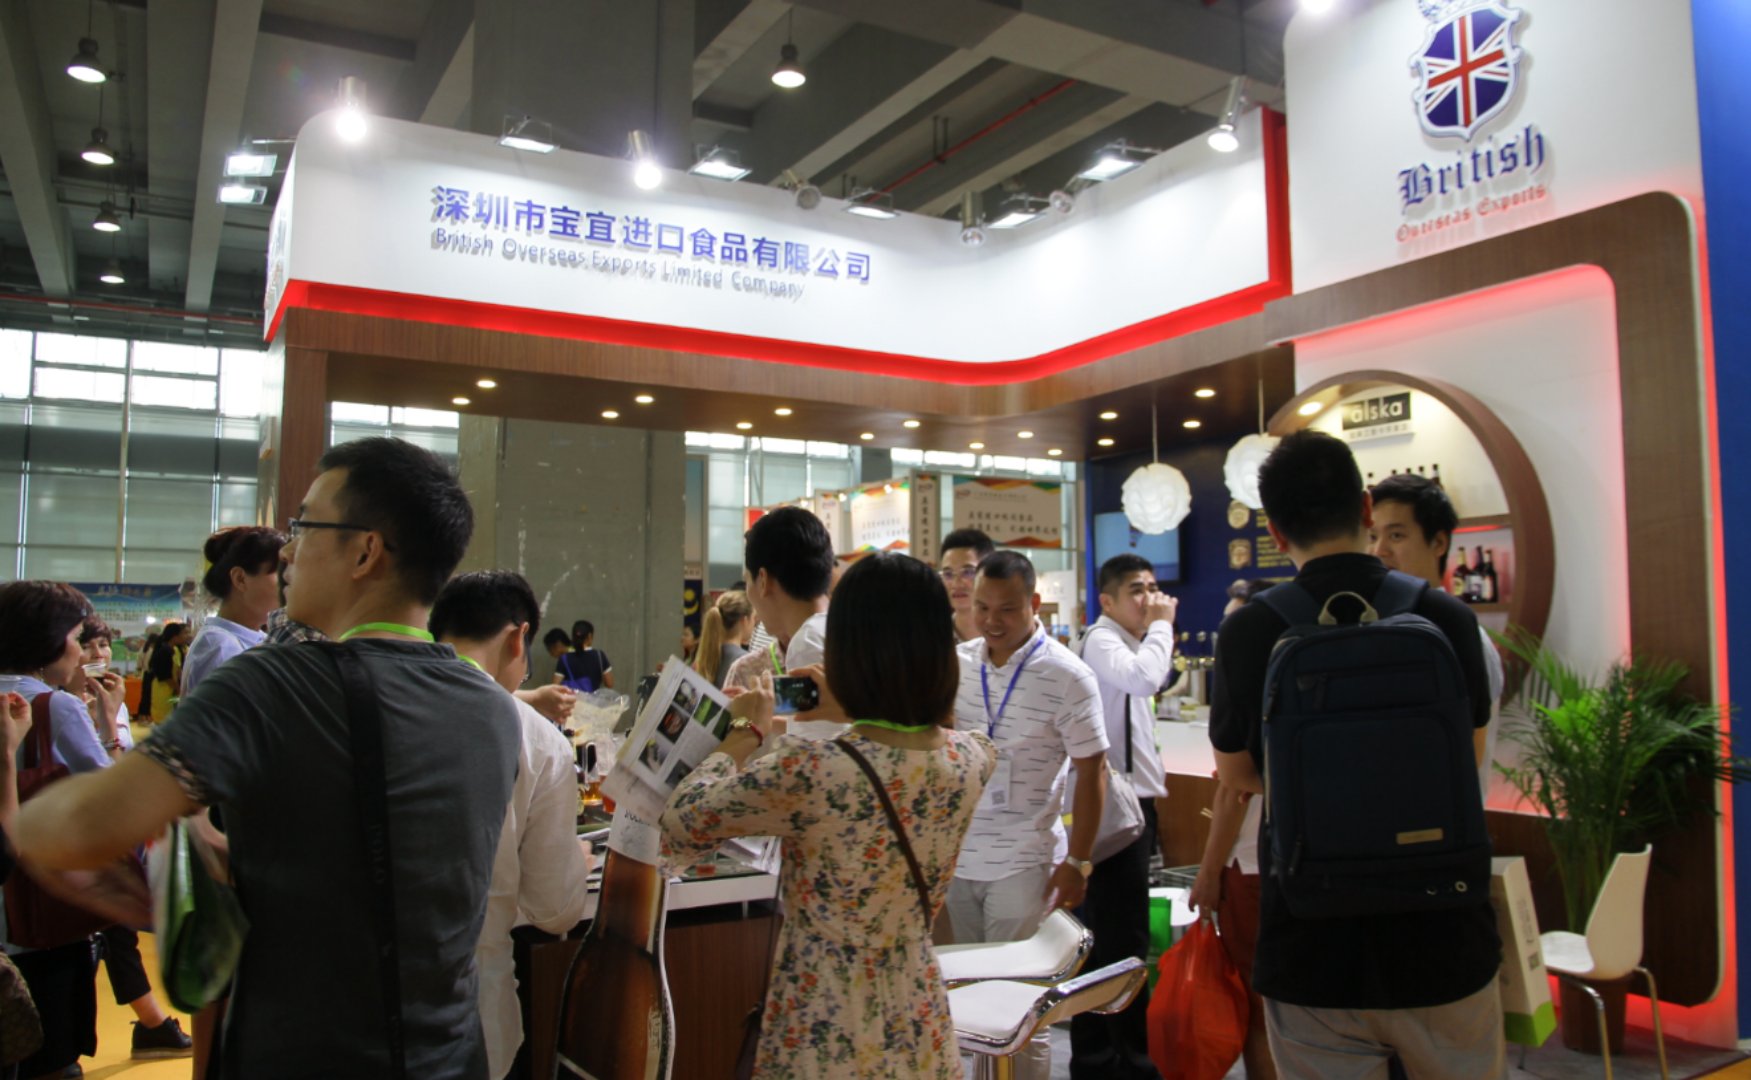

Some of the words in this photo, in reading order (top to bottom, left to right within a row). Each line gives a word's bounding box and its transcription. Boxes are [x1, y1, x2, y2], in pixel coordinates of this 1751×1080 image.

[1398, 122, 1545, 215] British
[1477, 184, 1547, 216] Exports
[434, 183, 873, 282] 深圳市宝宜进口食品有限公司
[435, 227, 494, 252] British
[503, 238, 586, 265] Overseas
[592, 250, 656, 274] Exports
[662, 260, 723, 284] Limited
[731, 271, 805, 300] Company
